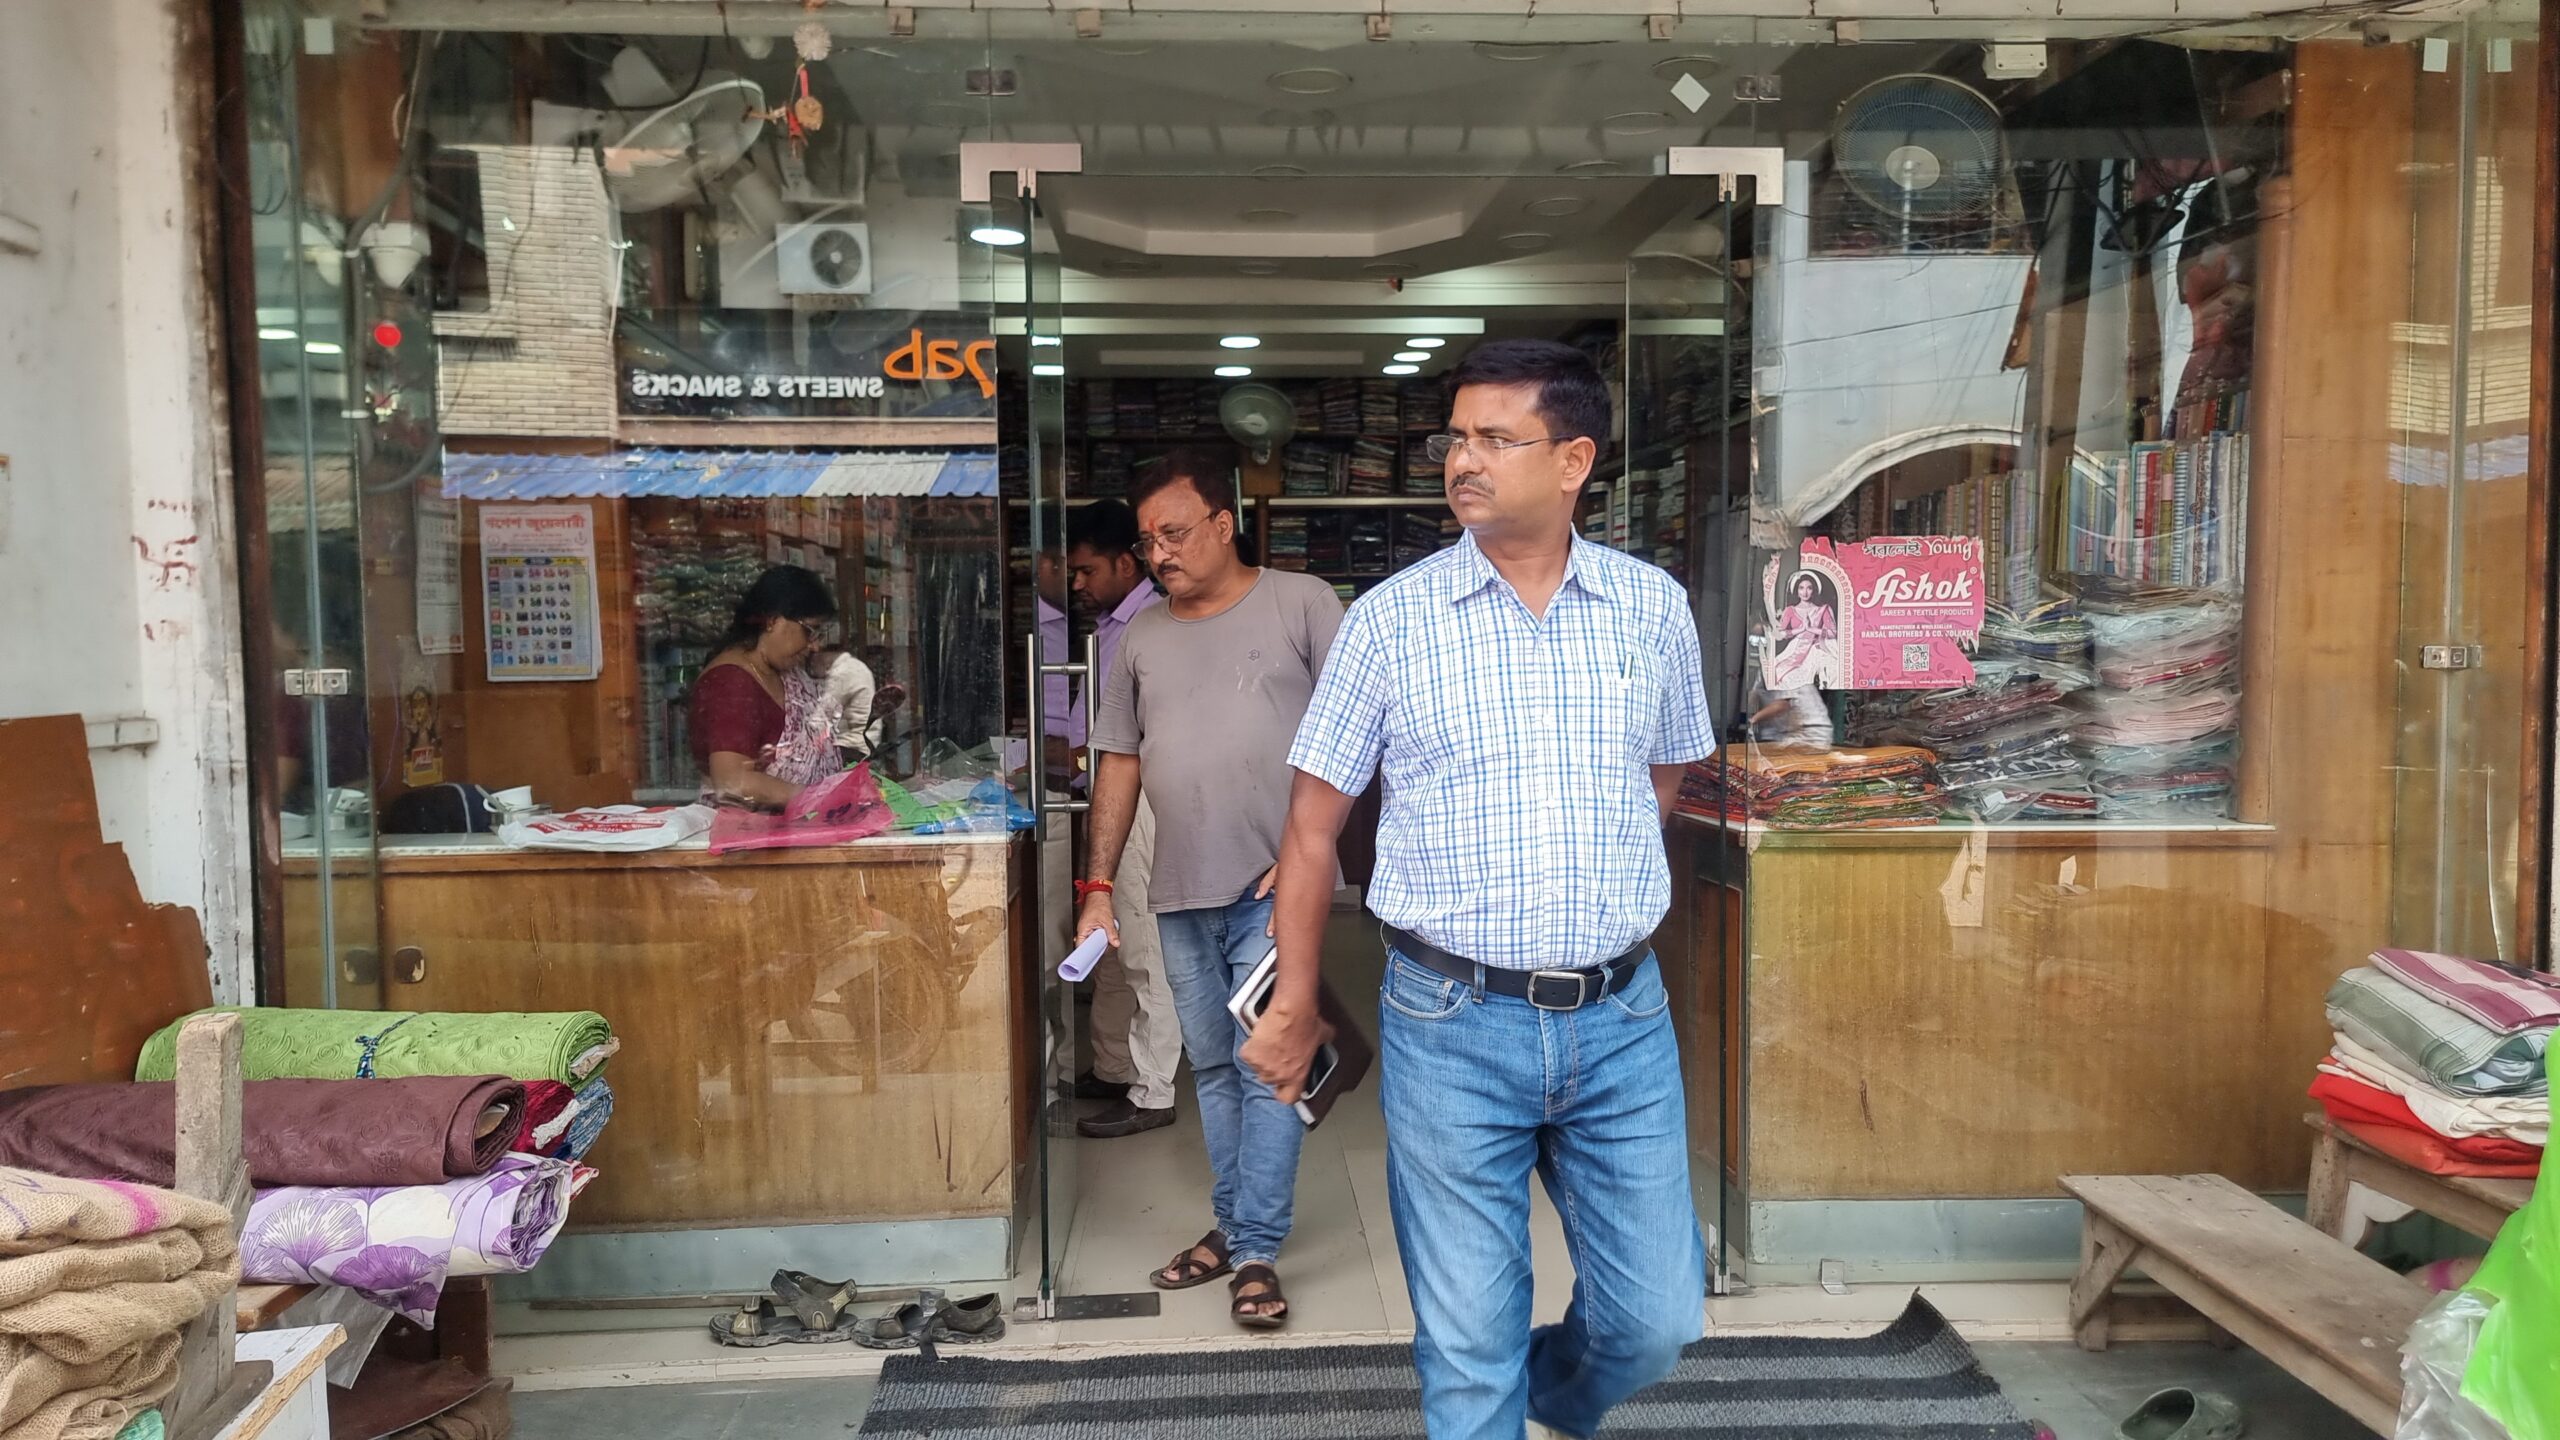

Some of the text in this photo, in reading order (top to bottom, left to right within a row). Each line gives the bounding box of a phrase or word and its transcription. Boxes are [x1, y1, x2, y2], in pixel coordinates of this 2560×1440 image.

[1925, 538, 1972, 561] Young
[1857, 567, 1973, 608] Ashok
[1880, 609, 1905, 617] SAREES
[1939, 608, 1974, 616] PRODUCTS
